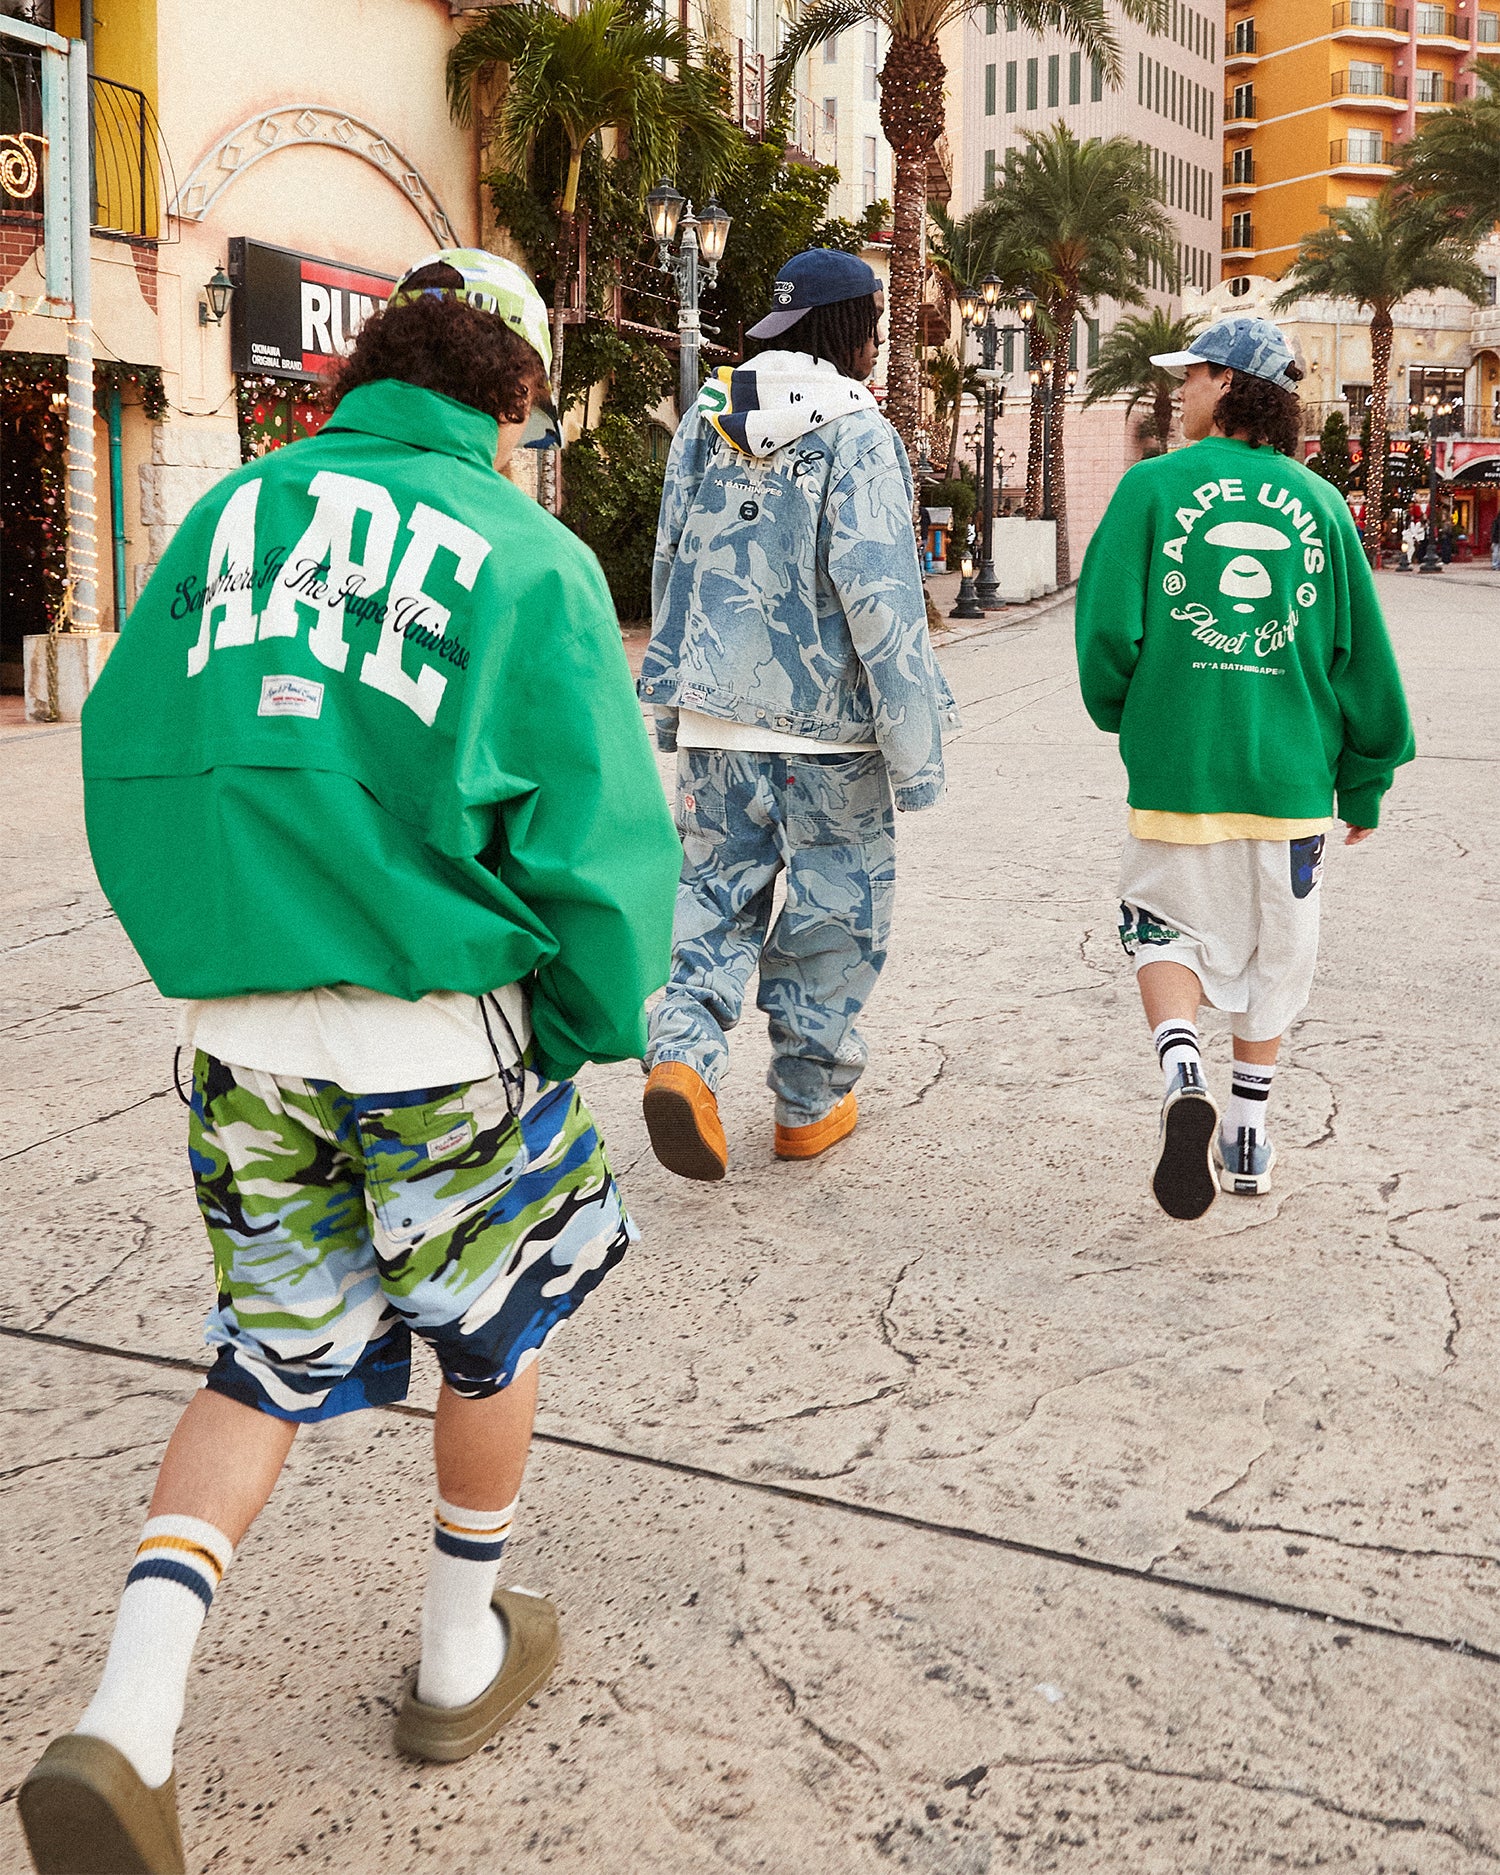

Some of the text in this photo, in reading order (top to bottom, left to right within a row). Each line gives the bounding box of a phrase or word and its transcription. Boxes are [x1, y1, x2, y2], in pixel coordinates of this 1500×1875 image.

[251, 354, 303, 371] ORIGINAL BRAND
[1163, 478, 1325, 575] AAPE UNVS
[257, 546, 284, 589] In
[284, 558, 331, 600] The
[328, 574, 389, 628] Aape
[393, 596, 470, 670] Universe
[1170, 602, 1250, 655] Planet
